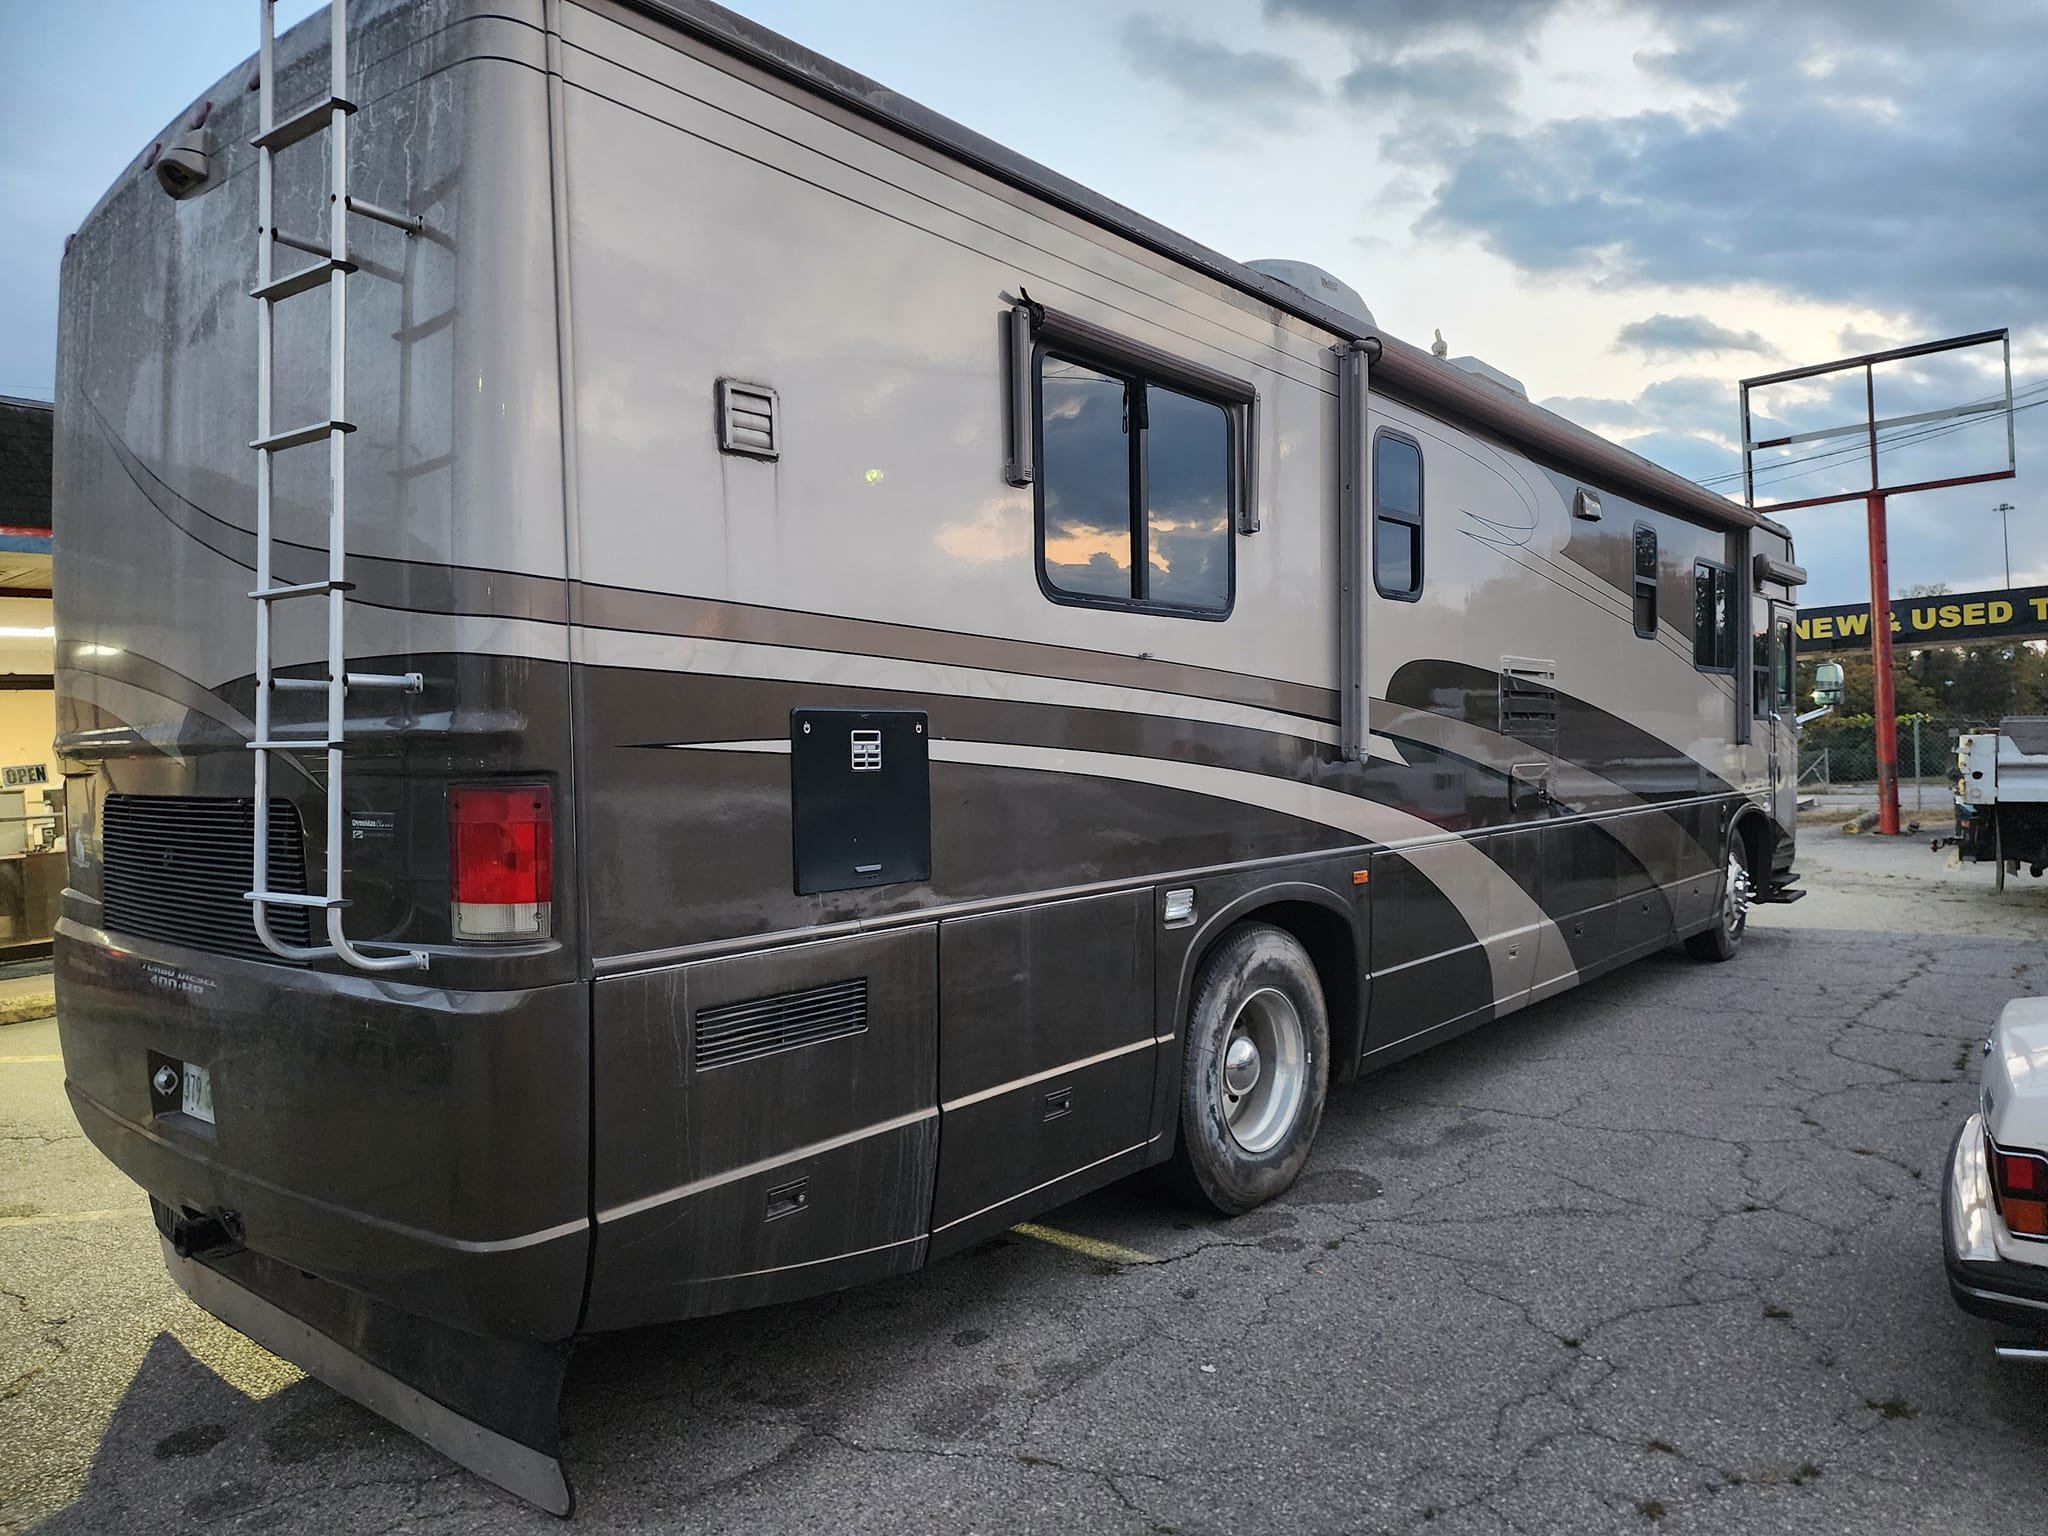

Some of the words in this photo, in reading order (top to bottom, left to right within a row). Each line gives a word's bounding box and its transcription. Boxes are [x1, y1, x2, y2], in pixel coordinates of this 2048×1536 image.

[1796, 613, 1868, 640] NEW
[1912, 601, 2013, 631] USED
[6, 766, 46, 784] OPEN
